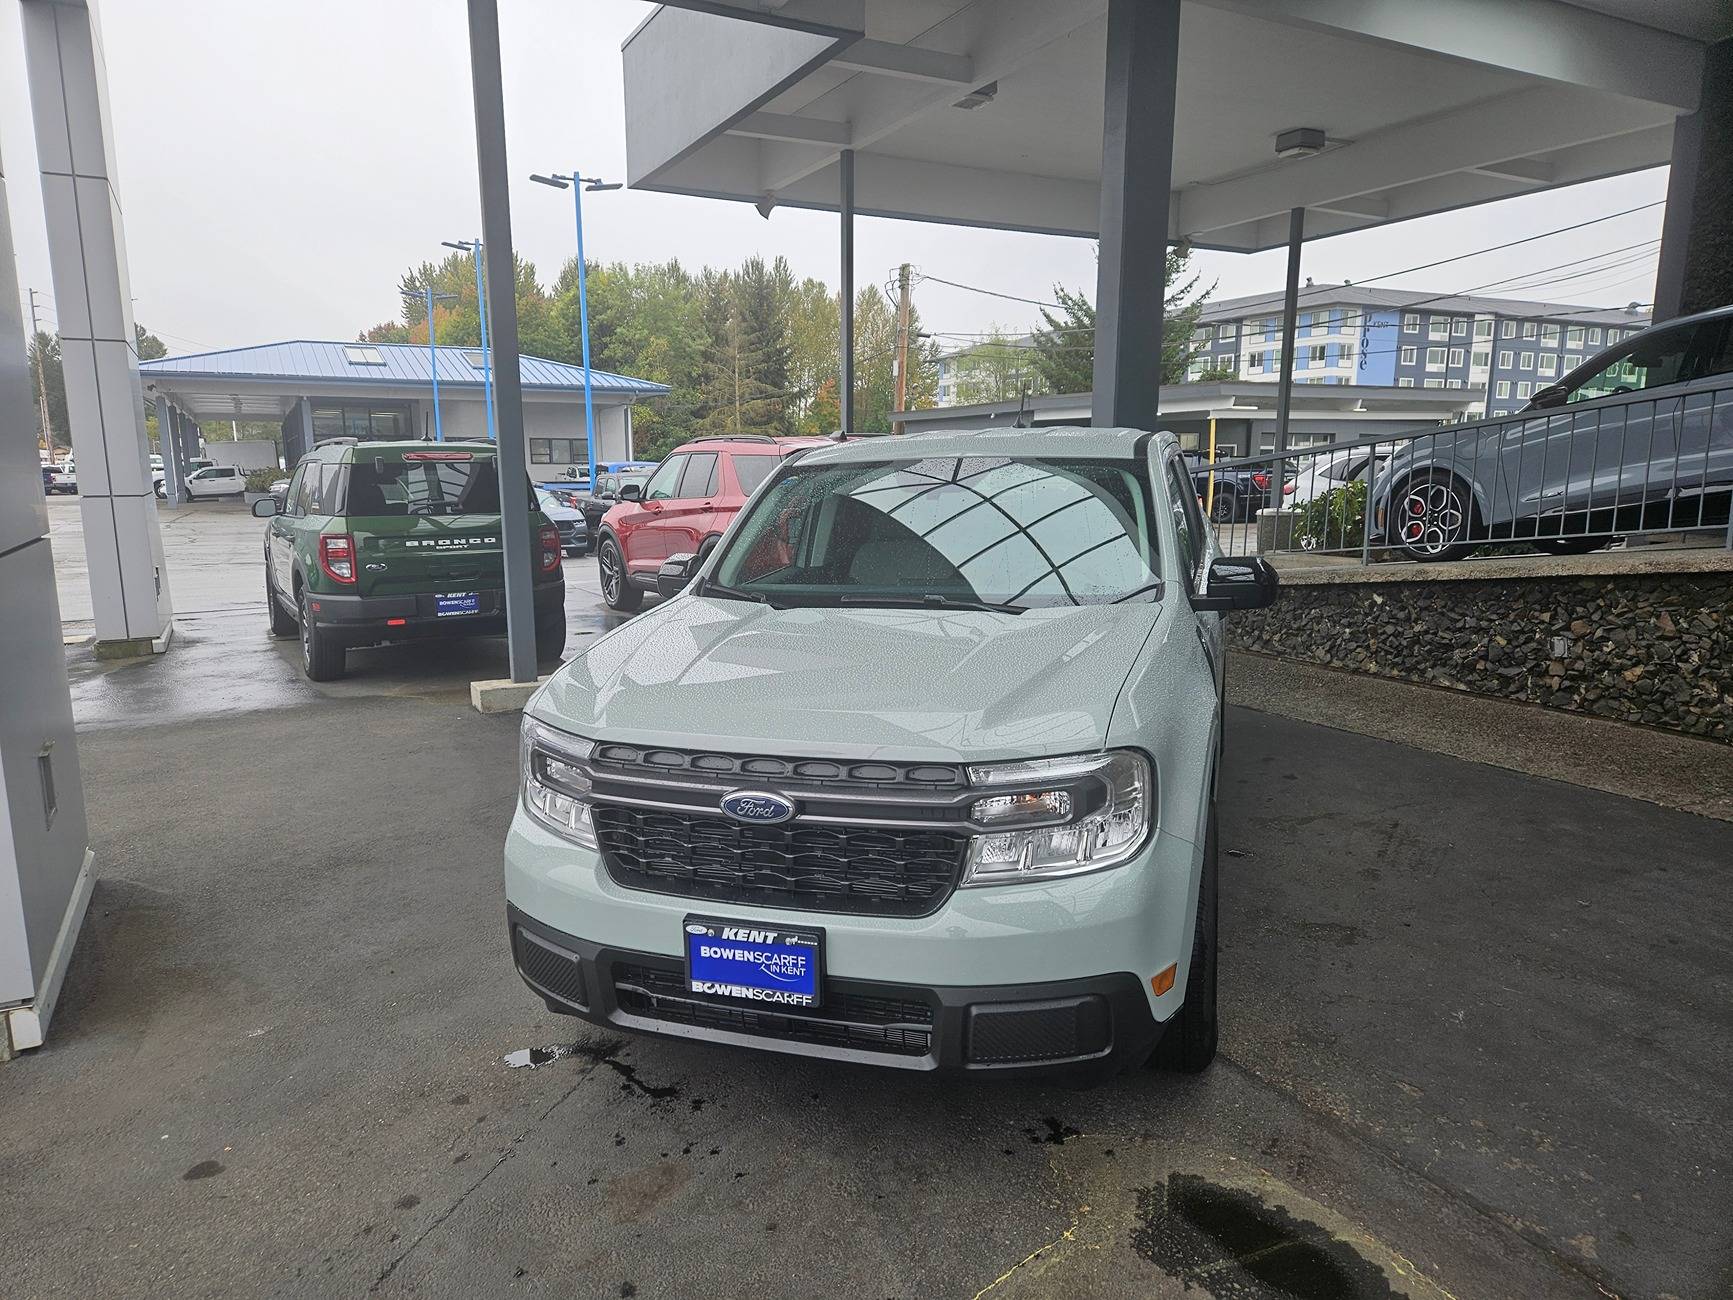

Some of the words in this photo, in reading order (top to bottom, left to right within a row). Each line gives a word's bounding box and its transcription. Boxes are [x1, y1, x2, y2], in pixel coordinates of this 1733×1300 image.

[405, 537, 496, 546] BRONCO
[736, 798, 775, 817] Ford
[722, 927, 778, 945] KENT
[700, 946, 806, 967] BOWENSCARFF
[770, 965, 780, 973] IN
[781, 966, 806, 976] KENT
[691, 981, 813, 1006] BOWENSCARFF
